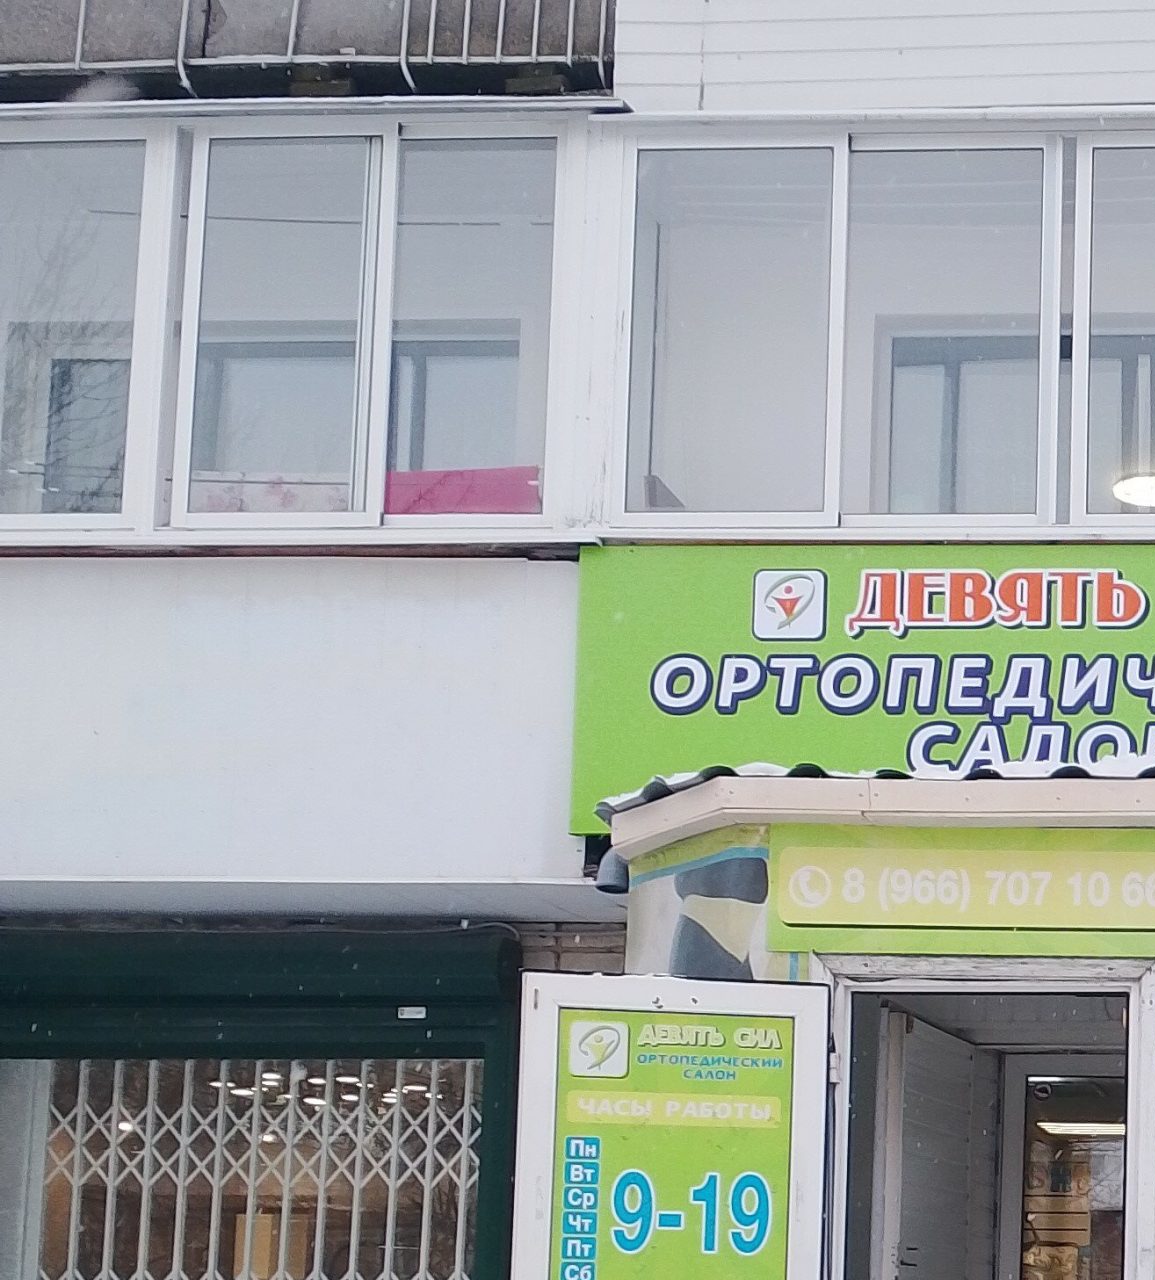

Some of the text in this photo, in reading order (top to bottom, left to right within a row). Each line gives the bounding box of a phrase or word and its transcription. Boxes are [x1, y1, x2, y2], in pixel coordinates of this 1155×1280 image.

[845, 567, 1150, 638] ДЕВЯТЬ
[841, 867, 866, 904] 8
[878, 866, 971, 912] (966)
[985, 871, 1053, 907] 707
[1067, 872, 1111, 907] 10
[637, 1023, 726, 1049] ДЕВЯТЬ
[683, 1069, 737, 1081] САЛОН
[578, 1098, 772, 1121] ЧАСЫ РАБОТЫ
[569, 1139, 598, 1159] Пн
[569, 1164, 596, 1182] Вт
[567, 1189, 595, 1210] Ср
[611, 1168, 772, 1256] 9-19
[567, 1215, 593, 1233] Чт
[566, 1240, 593, 1258] Пт
